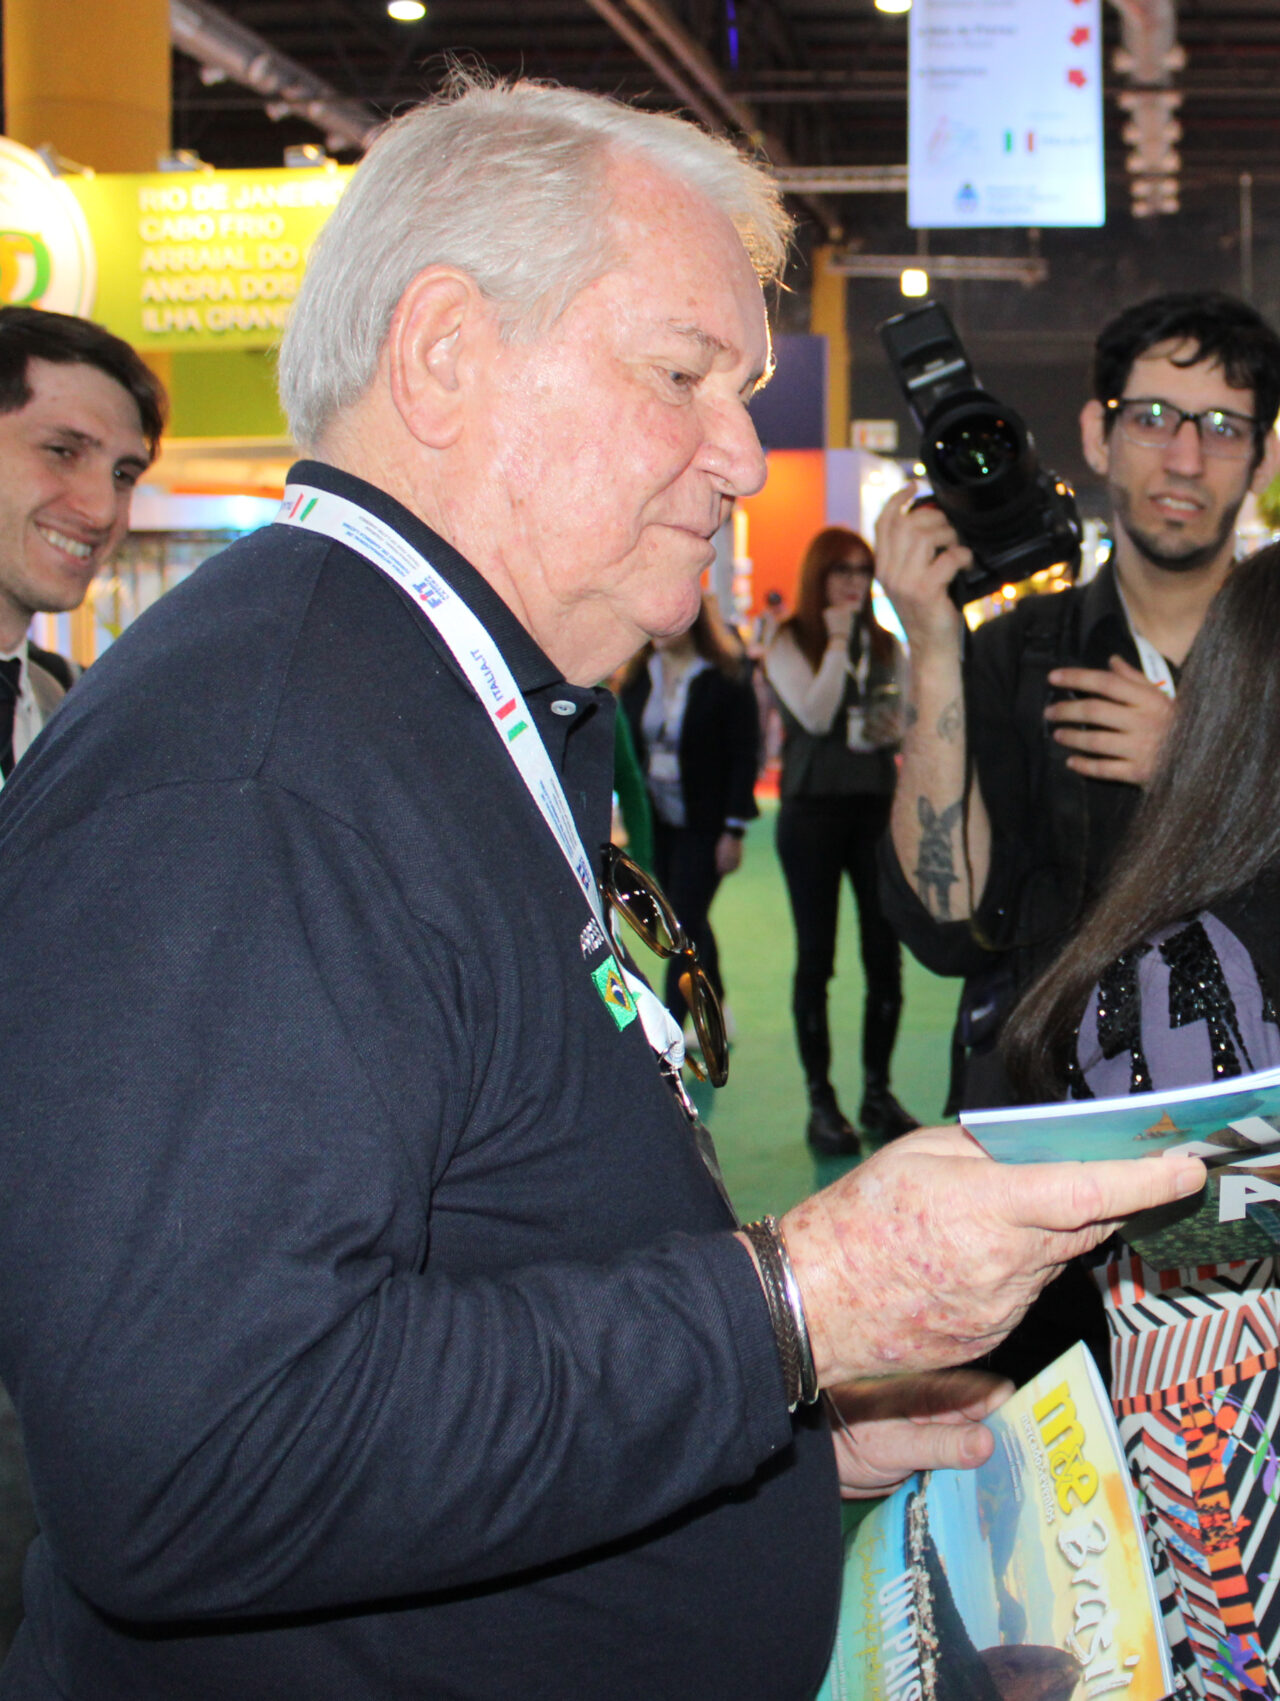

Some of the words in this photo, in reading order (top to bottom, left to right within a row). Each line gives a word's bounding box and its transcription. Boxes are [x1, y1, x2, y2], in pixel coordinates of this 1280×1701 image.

[138, 186, 188, 212] RIO
[190, 183, 229, 210] DE
[138, 214, 215, 242] CABO
[219, 212, 285, 240] FRIO
[141, 245, 253, 272] ARRAIAL
[257, 243, 299, 270] DO
[141, 275, 236, 303] ANGRA
[141, 307, 202, 333] ILHA
[206, 304, 289, 332] GRAN
[470, 648, 503, 702] ITALIA.IT
[878, 1566, 920, 1632] UN
[1058, 1516, 1140, 1700] Brasil
